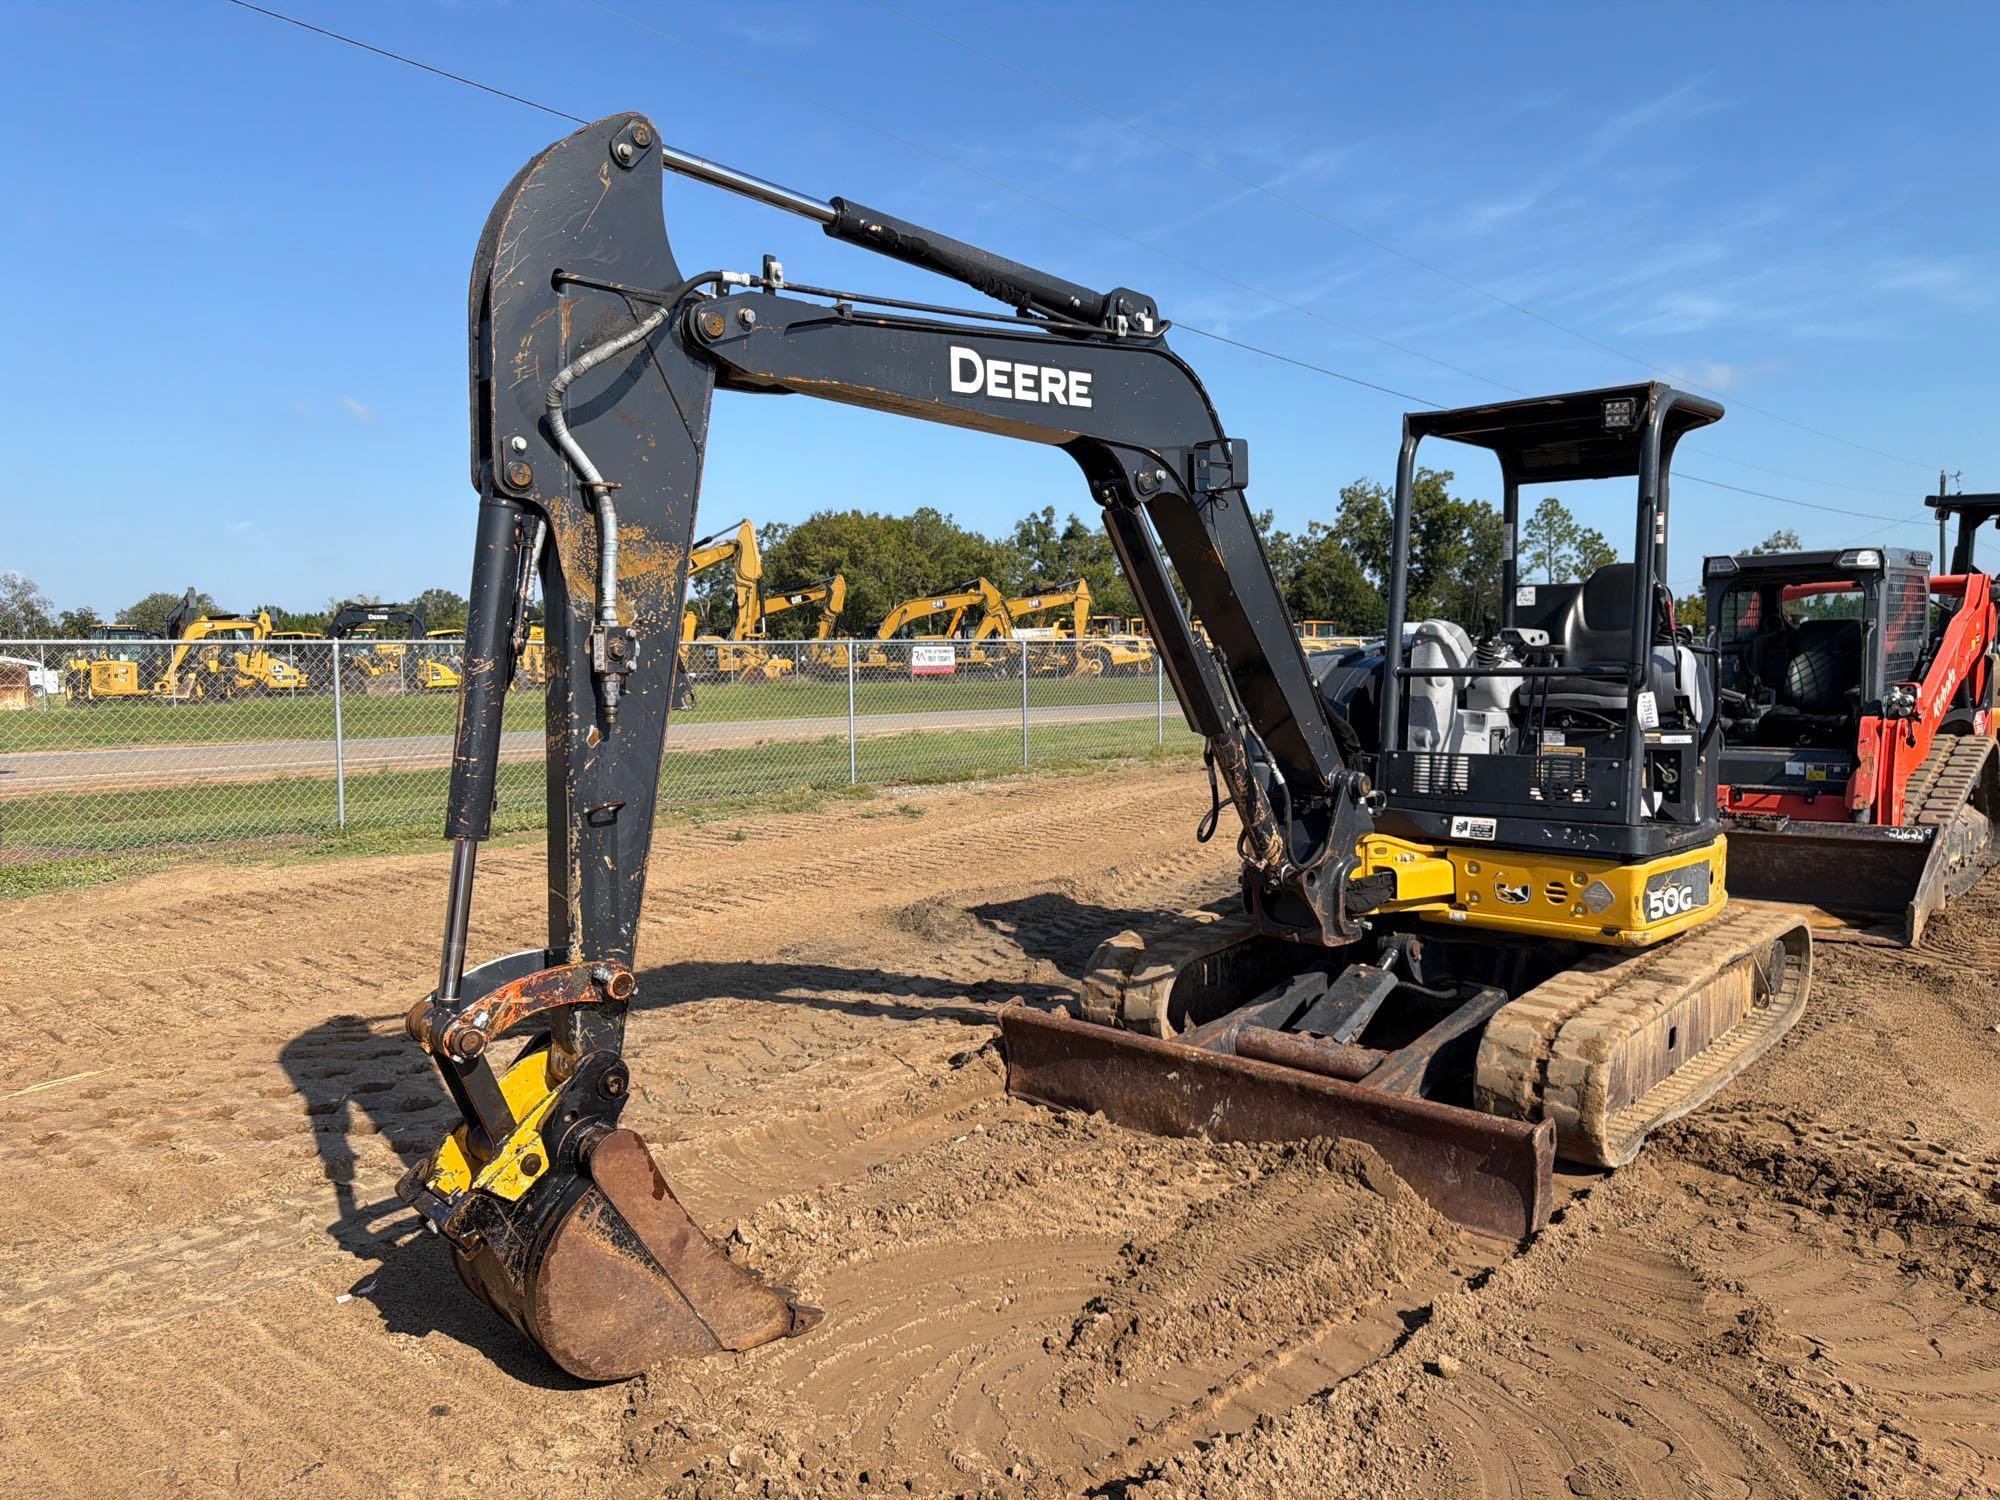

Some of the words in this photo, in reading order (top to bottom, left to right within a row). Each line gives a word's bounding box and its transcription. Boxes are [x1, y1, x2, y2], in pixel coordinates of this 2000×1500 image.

[951, 346, 1092, 408] DEERE
[932, 601, 944, 609] CAT
[1028, 600, 1040, 608] CAT
[1933, 667, 1956, 719] Kubota
[1650, 886, 1692, 919] 50G
